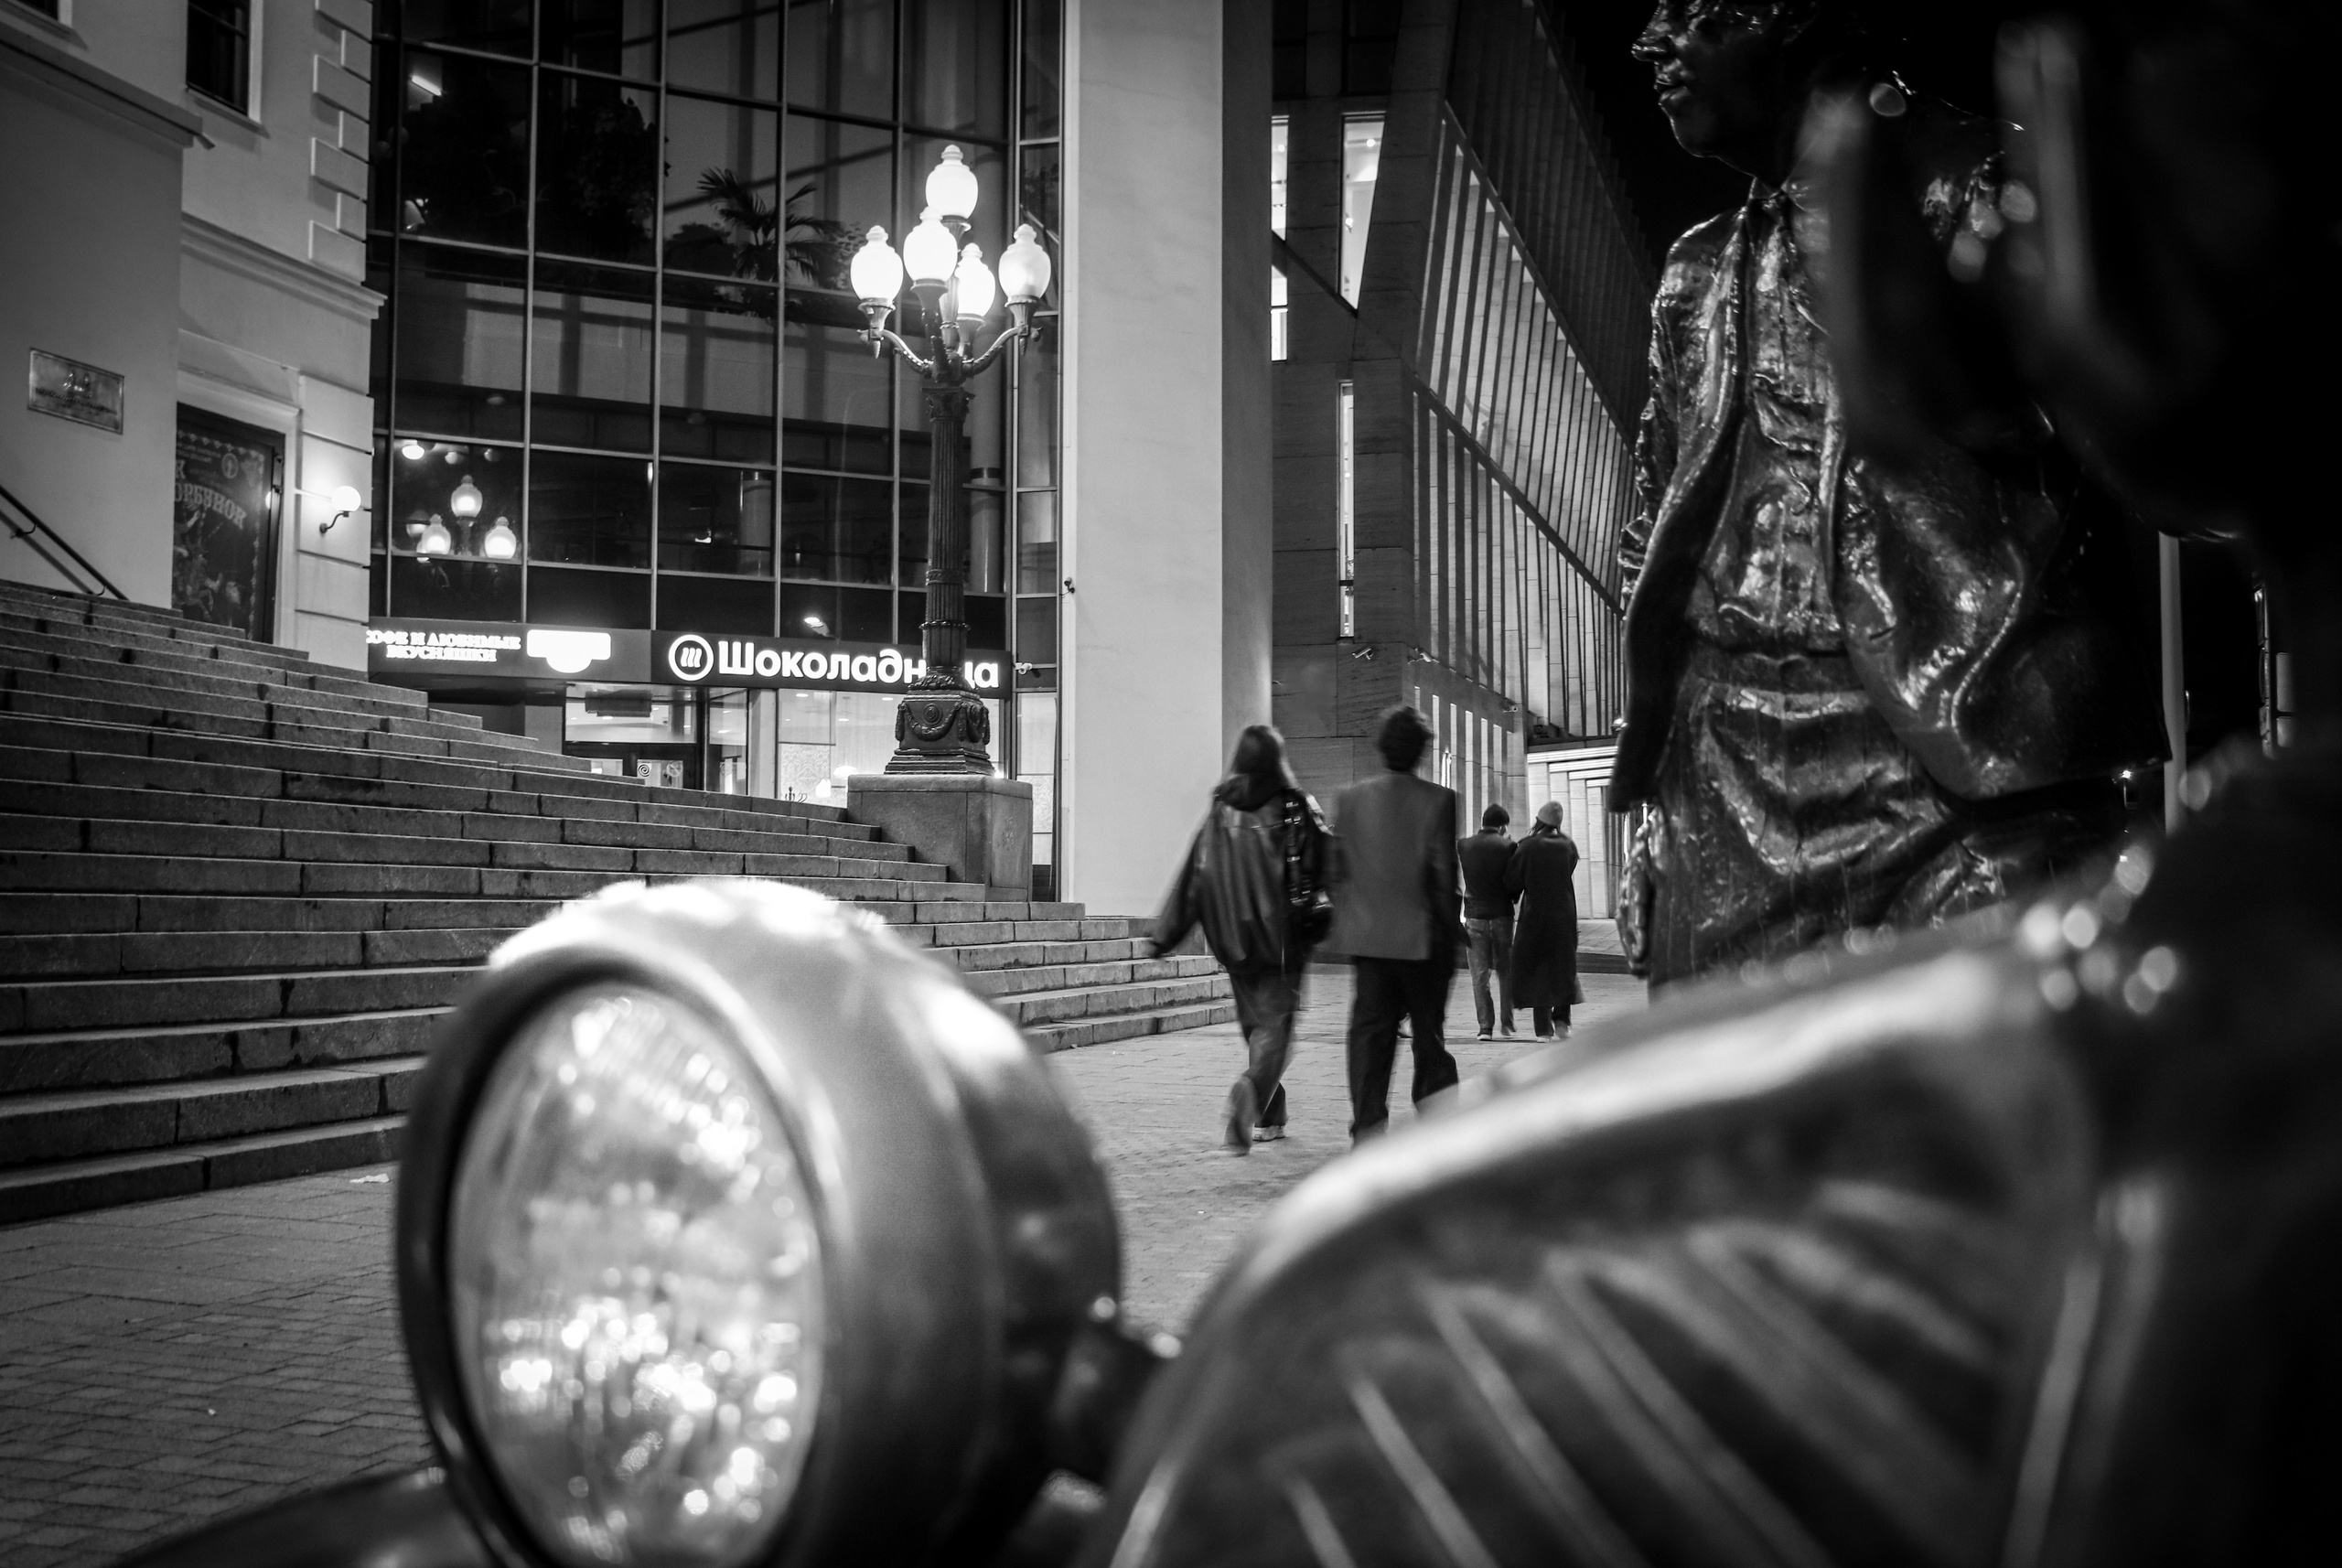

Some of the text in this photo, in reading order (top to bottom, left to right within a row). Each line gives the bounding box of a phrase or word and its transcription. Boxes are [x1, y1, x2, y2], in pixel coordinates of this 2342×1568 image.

[175, 482, 247, 530] ОРБУНОК
[410, 631, 426, 646] И
[718, 640, 999, 690] Шоколадна
